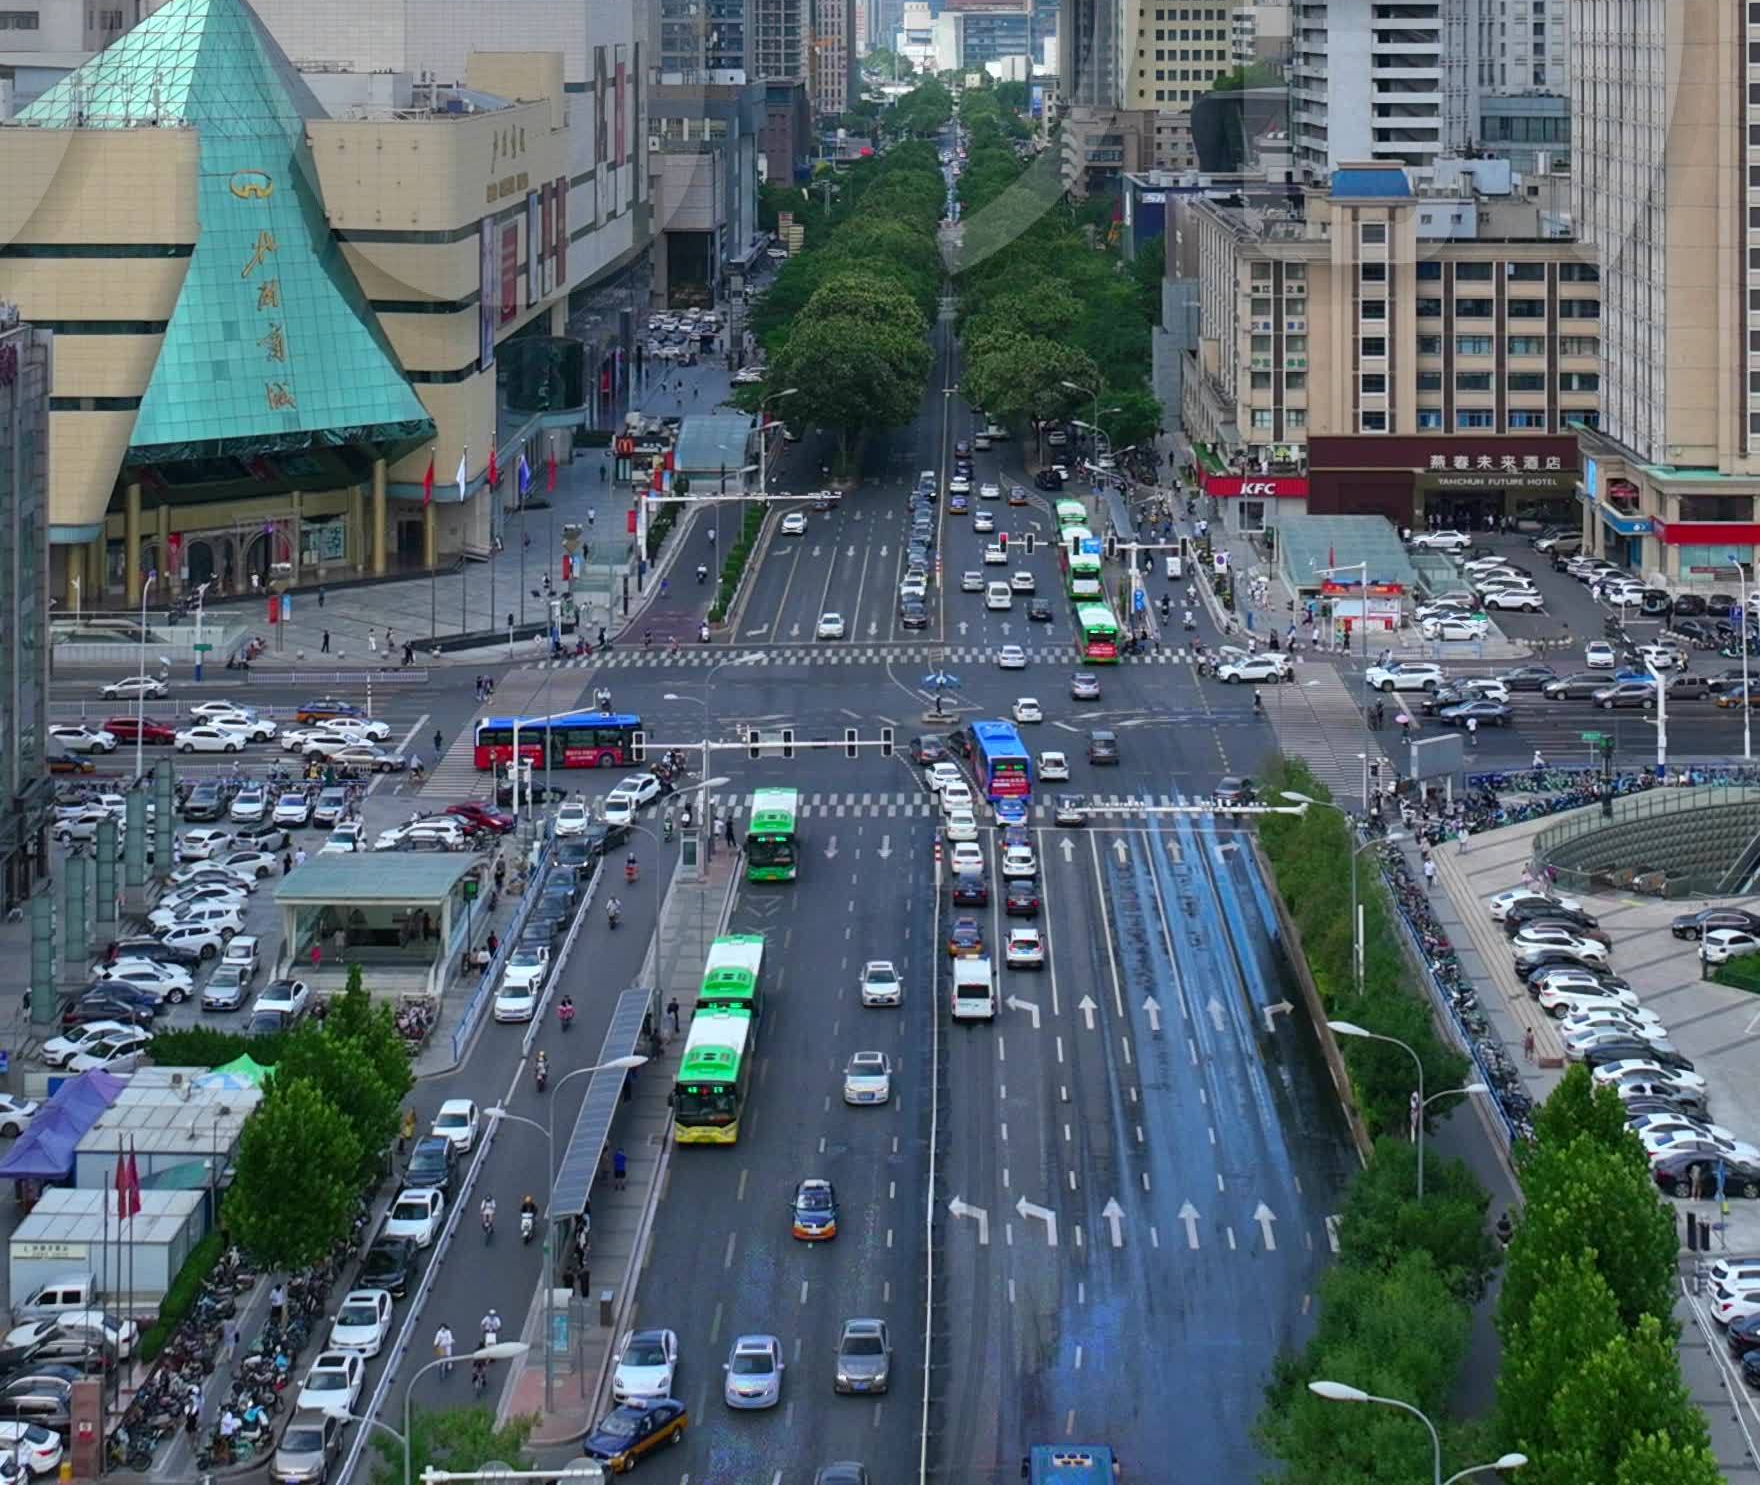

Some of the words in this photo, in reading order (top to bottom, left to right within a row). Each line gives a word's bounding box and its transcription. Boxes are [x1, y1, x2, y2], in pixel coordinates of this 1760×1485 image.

[1429, 455, 1562, 470] 燕春未来酒店
[1240, 482, 1276, 495] KFC
[1527, 478, 1559, 486] HOTEL
